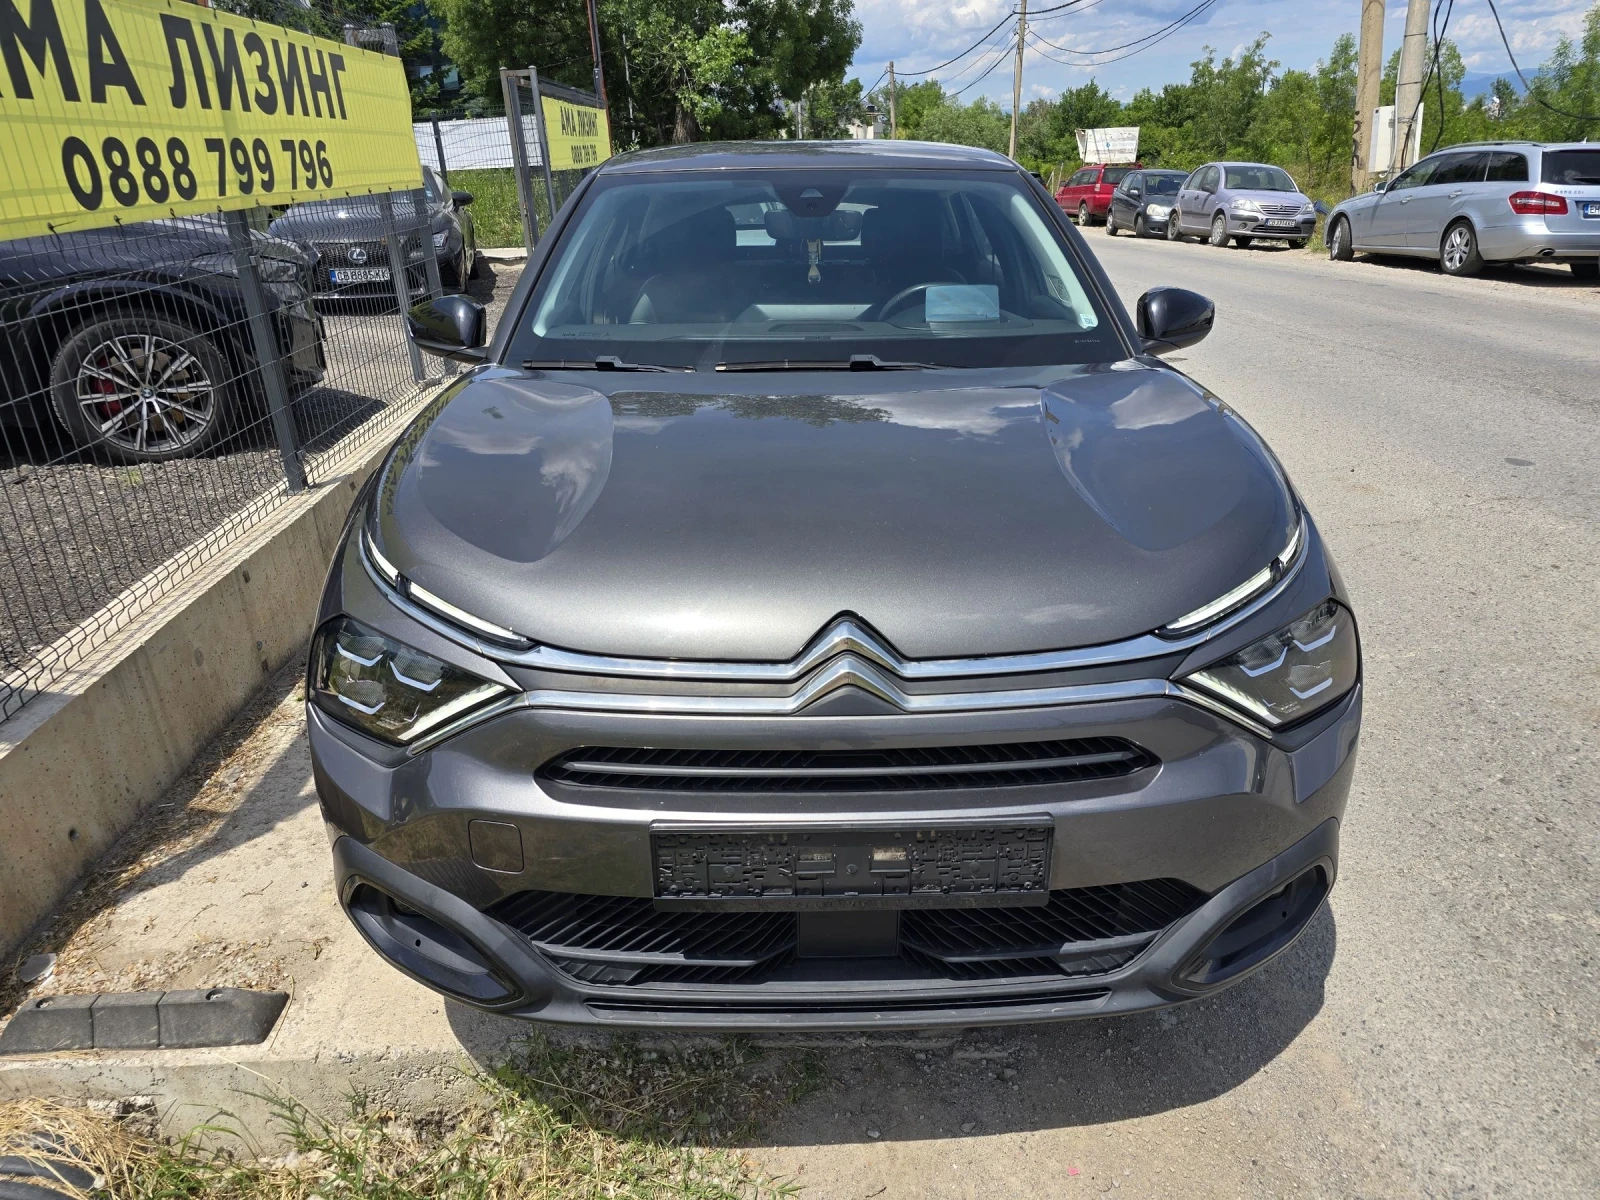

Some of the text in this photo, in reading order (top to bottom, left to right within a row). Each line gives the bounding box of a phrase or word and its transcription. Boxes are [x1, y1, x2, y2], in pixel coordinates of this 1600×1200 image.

[0, 0, 348, 121] МА ЛИЗИНГ
[62, 136, 333, 211] 0888 799 796
